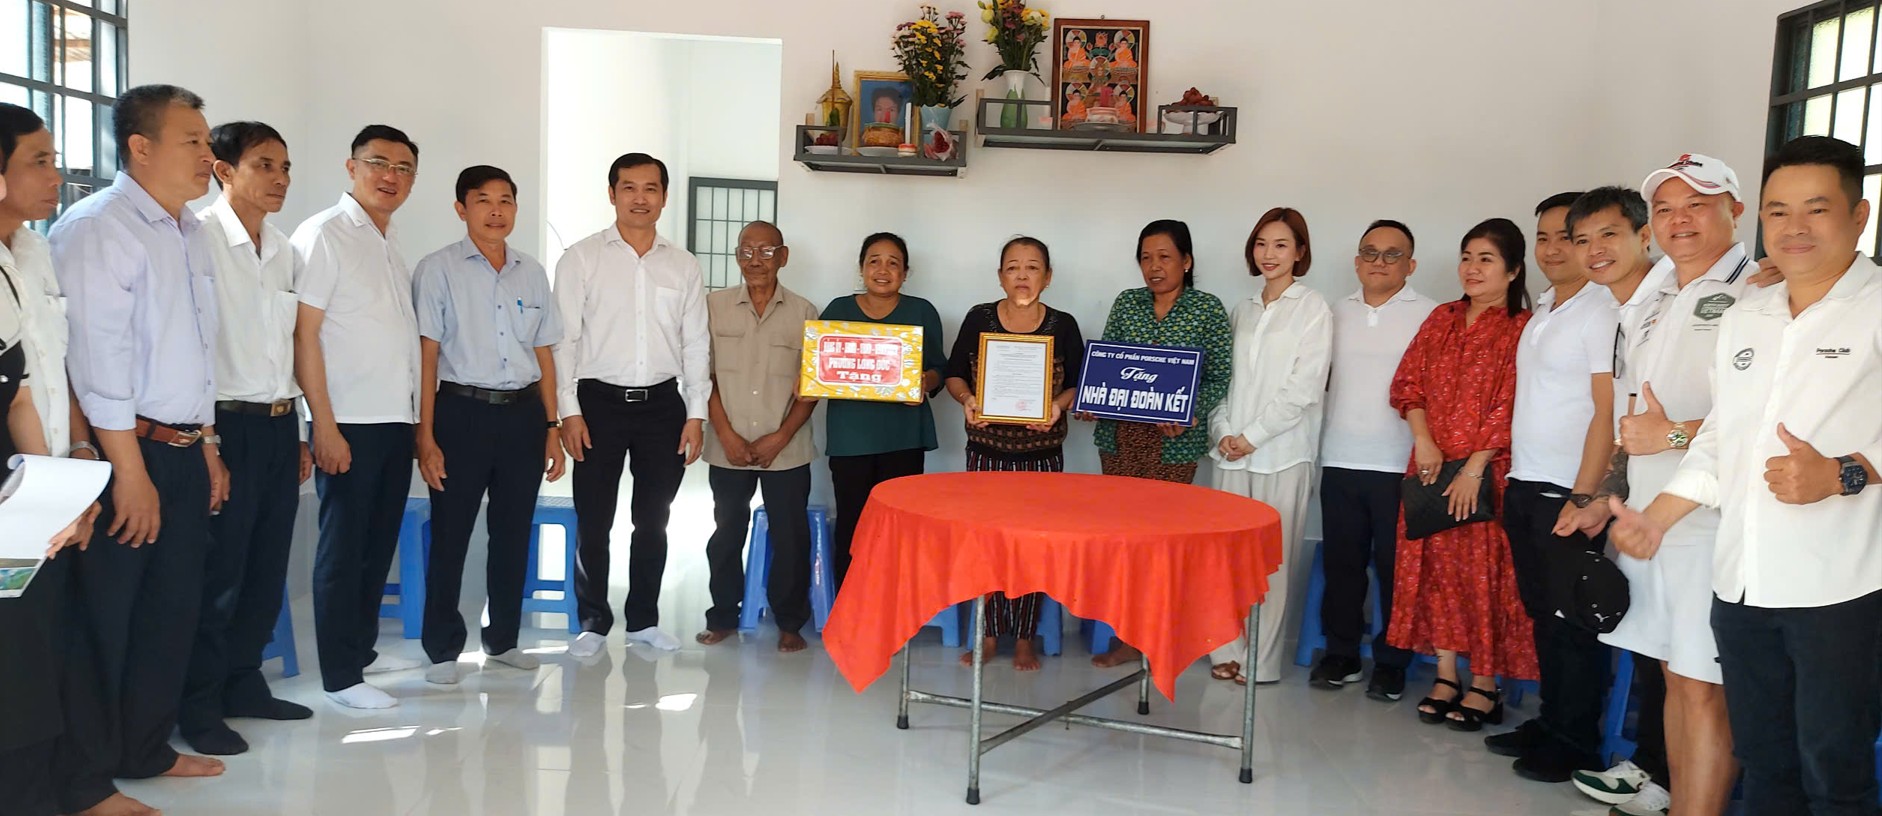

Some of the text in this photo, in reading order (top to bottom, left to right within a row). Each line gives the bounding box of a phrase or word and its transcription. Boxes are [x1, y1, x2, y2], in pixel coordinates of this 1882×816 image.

[1091, 350, 1107, 358] CÔNG
[1140, 355, 1166, 363] PORSCHE
[1167, 357, 1181, 365] VIỆT
[1120, 366, 1158, 383] Tặng
[1082, 382, 1189, 413] NHÀ ĐẠI ĐOÀN KẾT
